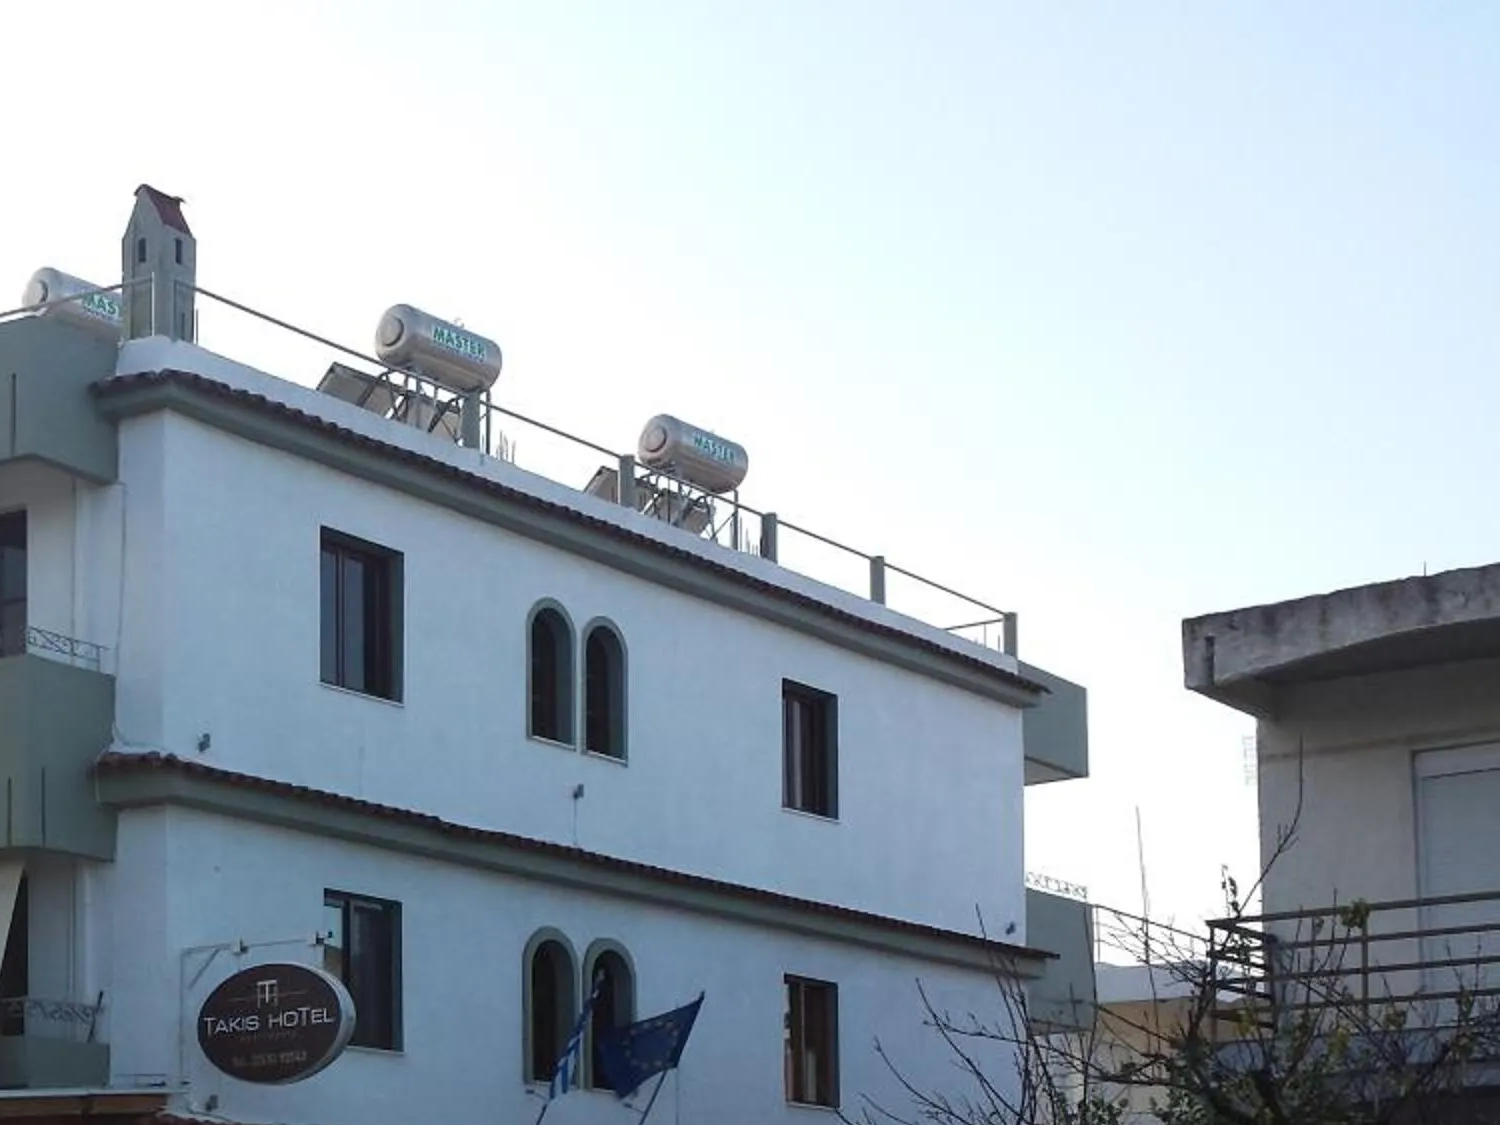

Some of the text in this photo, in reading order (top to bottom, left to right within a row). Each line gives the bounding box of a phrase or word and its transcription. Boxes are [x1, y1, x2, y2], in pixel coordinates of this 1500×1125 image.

[433, 325, 485, 358] MASTER
[204, 1014, 260, 1037] TAKIS
[268, 1007, 335, 1028] HOTEL
